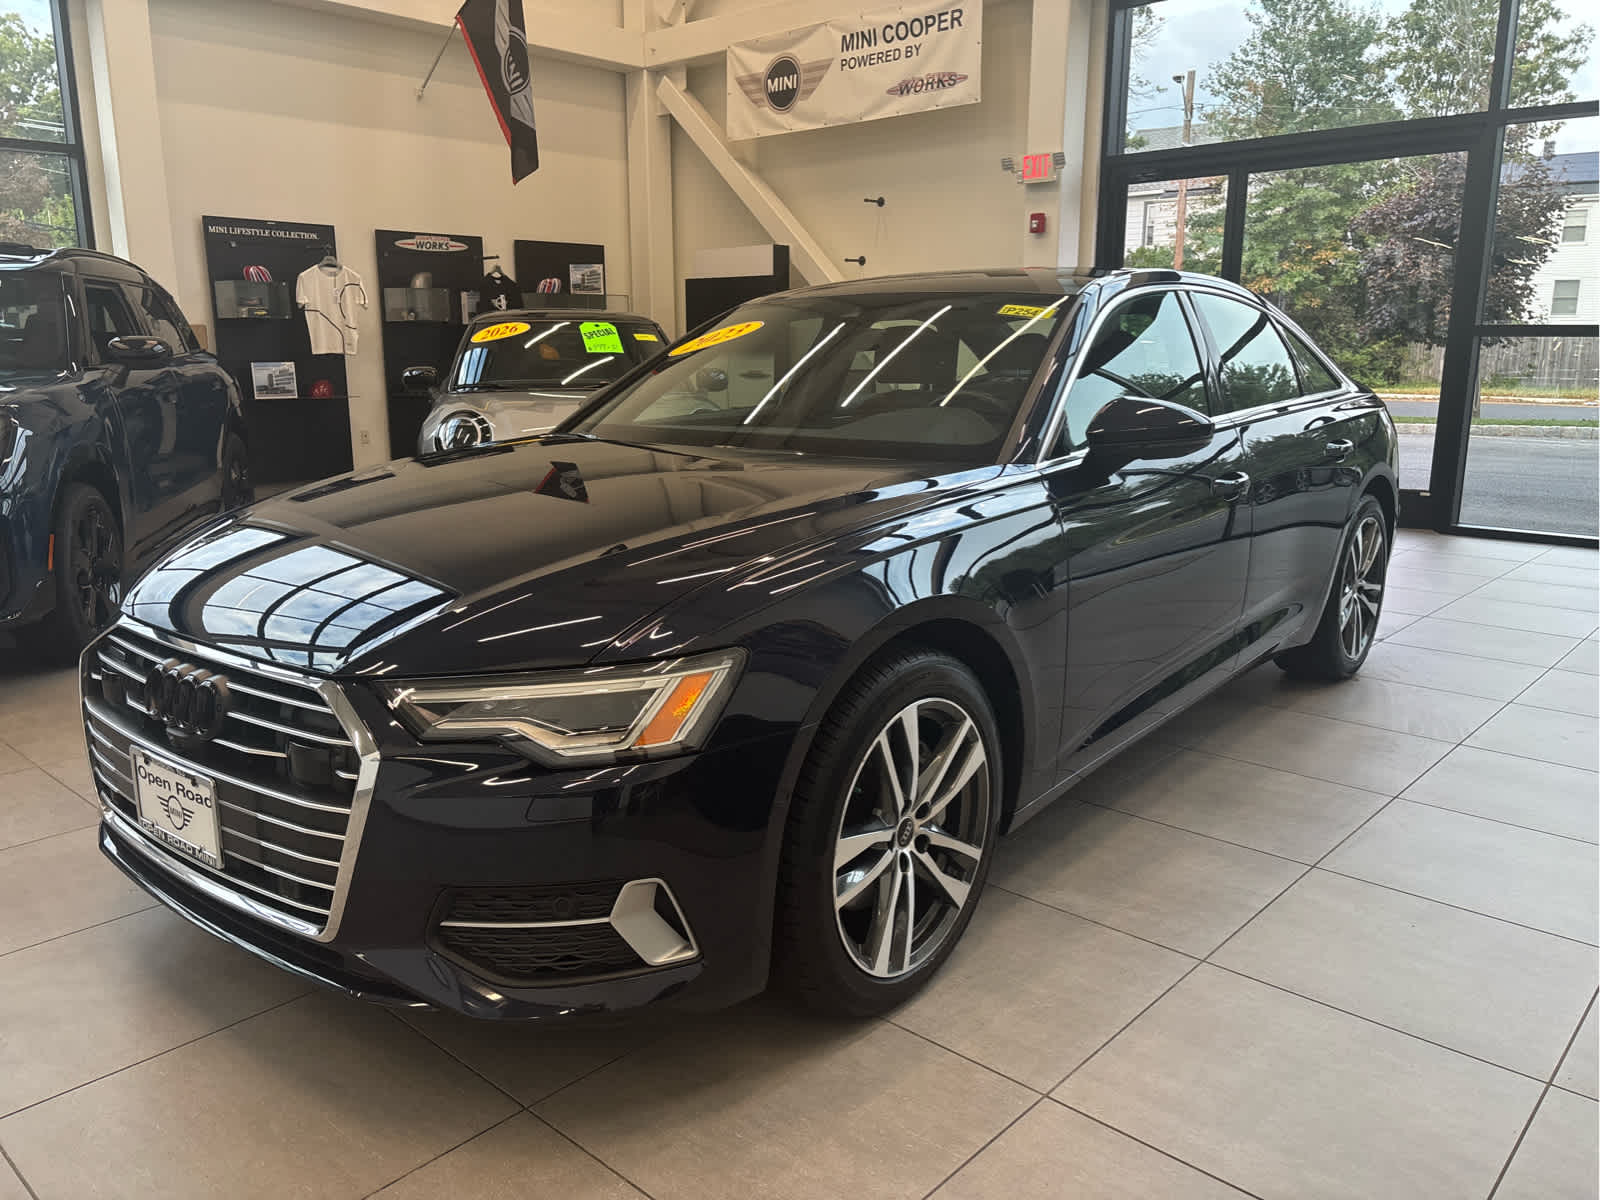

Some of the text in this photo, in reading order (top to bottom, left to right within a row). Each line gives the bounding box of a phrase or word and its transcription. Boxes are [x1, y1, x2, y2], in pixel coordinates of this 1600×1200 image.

[841, 8, 964, 53] MINI COOPER
[840, 43, 922, 71] POWERED BY
[767, 73, 798, 94] MINI
[899, 74, 958, 96] WORKS
[1023, 153, 1051, 179] EXIT
[208, 225, 228, 234] MINI
[229, 226, 271, 237] LIFESTYLE
[416, 239, 450, 250] WORKS
[480, 325, 519, 340] 2026
[584, 327, 616, 340] SPECIAL
[137, 765, 171, 791] Open
[176, 781, 212, 808] Road
[142, 821, 217, 868] OPEN ROAD MINI
